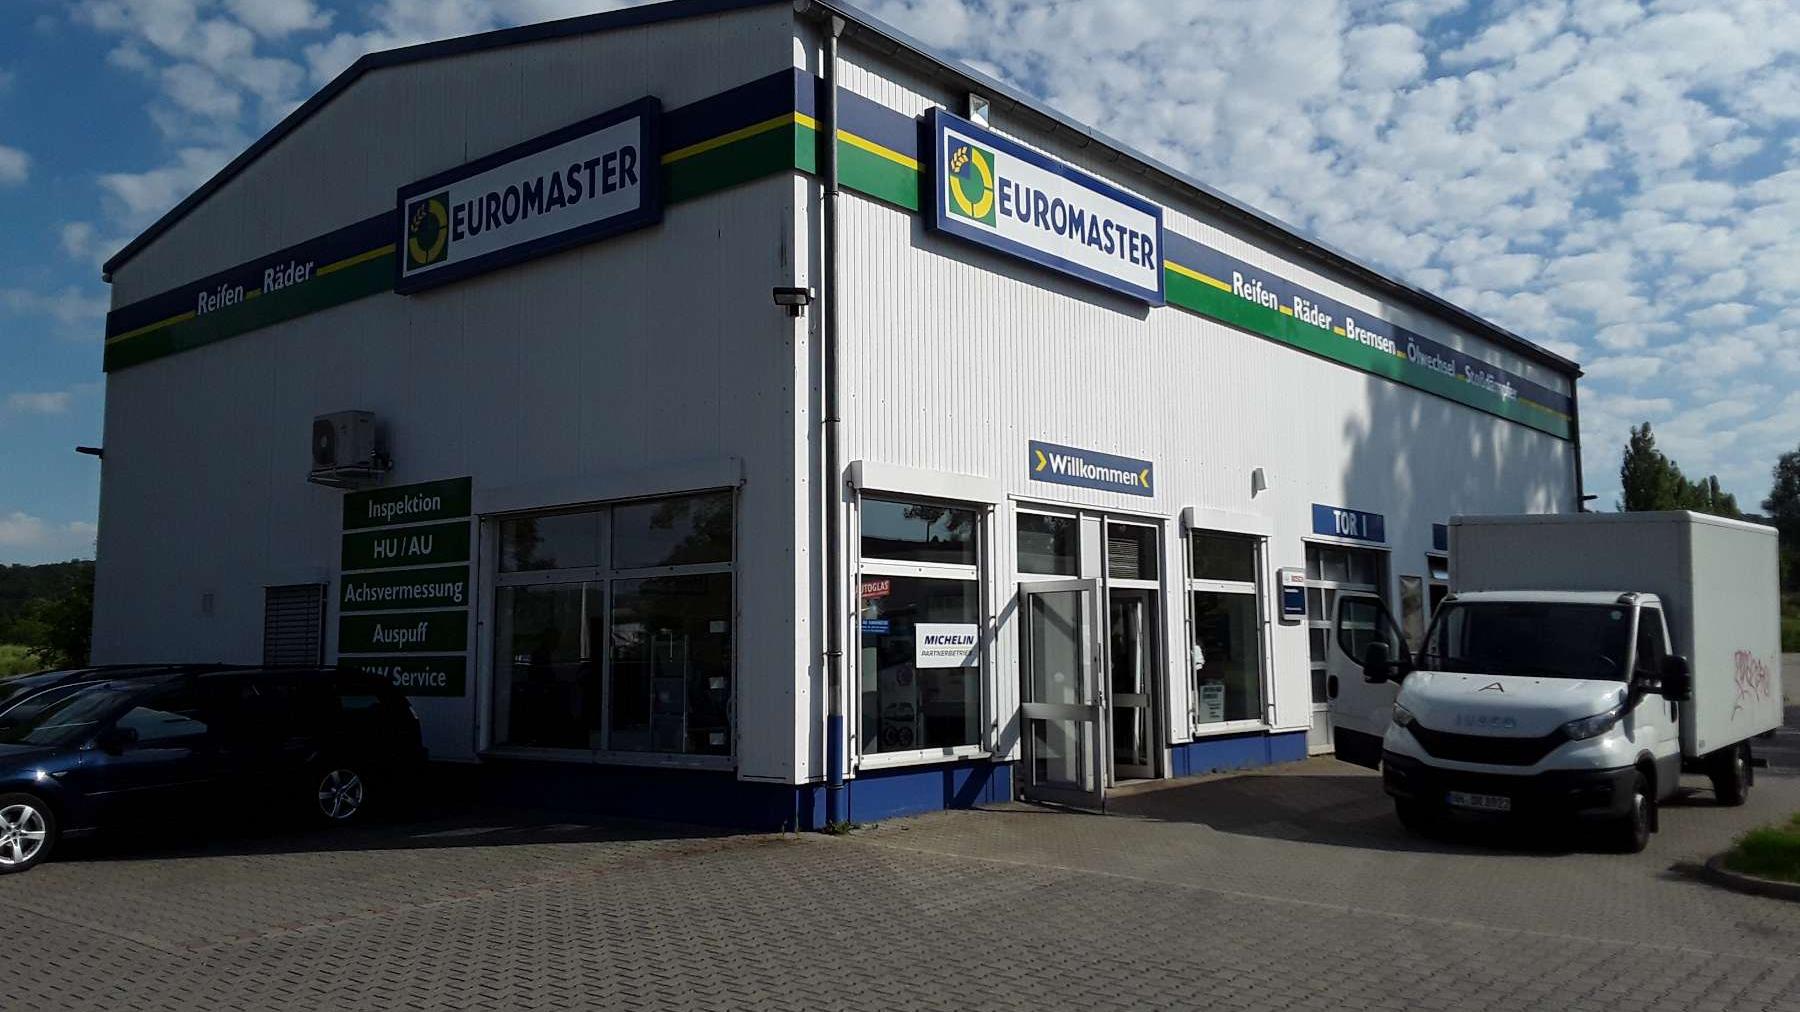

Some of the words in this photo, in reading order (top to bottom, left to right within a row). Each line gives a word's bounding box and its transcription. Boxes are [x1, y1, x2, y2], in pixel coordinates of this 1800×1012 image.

[452, 146, 638, 242] EUROMASTER
[998, 175, 1155, 271] EUROMASTER
[197, 283, 244, 316] Reifen
[263, 260, 314, 295] Räder
[1231, 271, 1279, 311] Reifen
[1293, 296, 1333, 331] Räder
[1345, 317, 1397, 356] Bremsen
[1048, 452, 1139, 486] Willkommen
[367, 493, 441, 522] Inspektion
[1333, 510, 1359, 536] TOR
[373, 537, 397, 559] HU
[408, 534, 433, 556] AU
[344, 581, 464, 603] Achsvermessung
[372, 621, 429, 649] Auspuff
[924, 634, 975, 646] MICHELIN
[392, 665, 447, 688] Service
